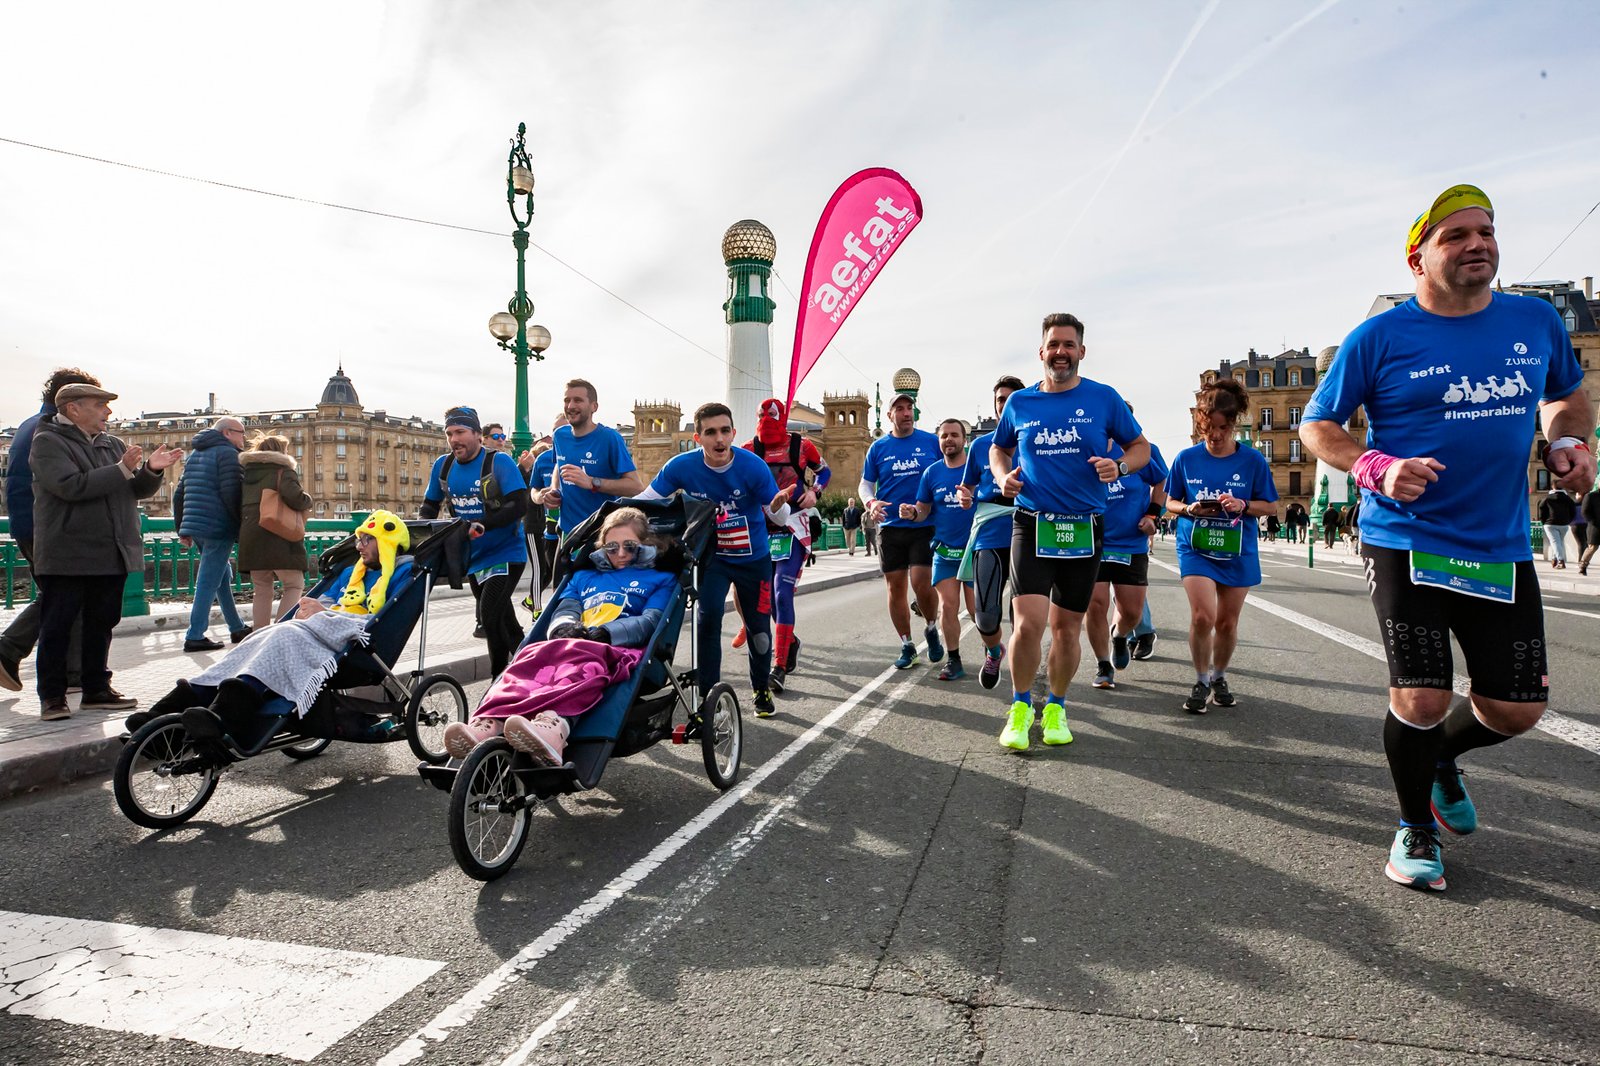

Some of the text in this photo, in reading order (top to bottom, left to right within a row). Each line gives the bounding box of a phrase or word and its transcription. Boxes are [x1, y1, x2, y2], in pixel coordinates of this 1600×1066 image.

[814, 196, 910, 313] aefat
[830, 211, 915, 323] www.aefat.es
[1505, 357, 1542, 366] ZURICH
[1409, 364, 1452, 379] aefat
[1444, 405, 1527, 420] #Imparables
[1022, 420, 1041, 428] aefat
[1036, 447, 1081, 456] #Imparables
[1055, 523, 1075, 531] XABIER
[1056, 532, 1075, 543] 2568
